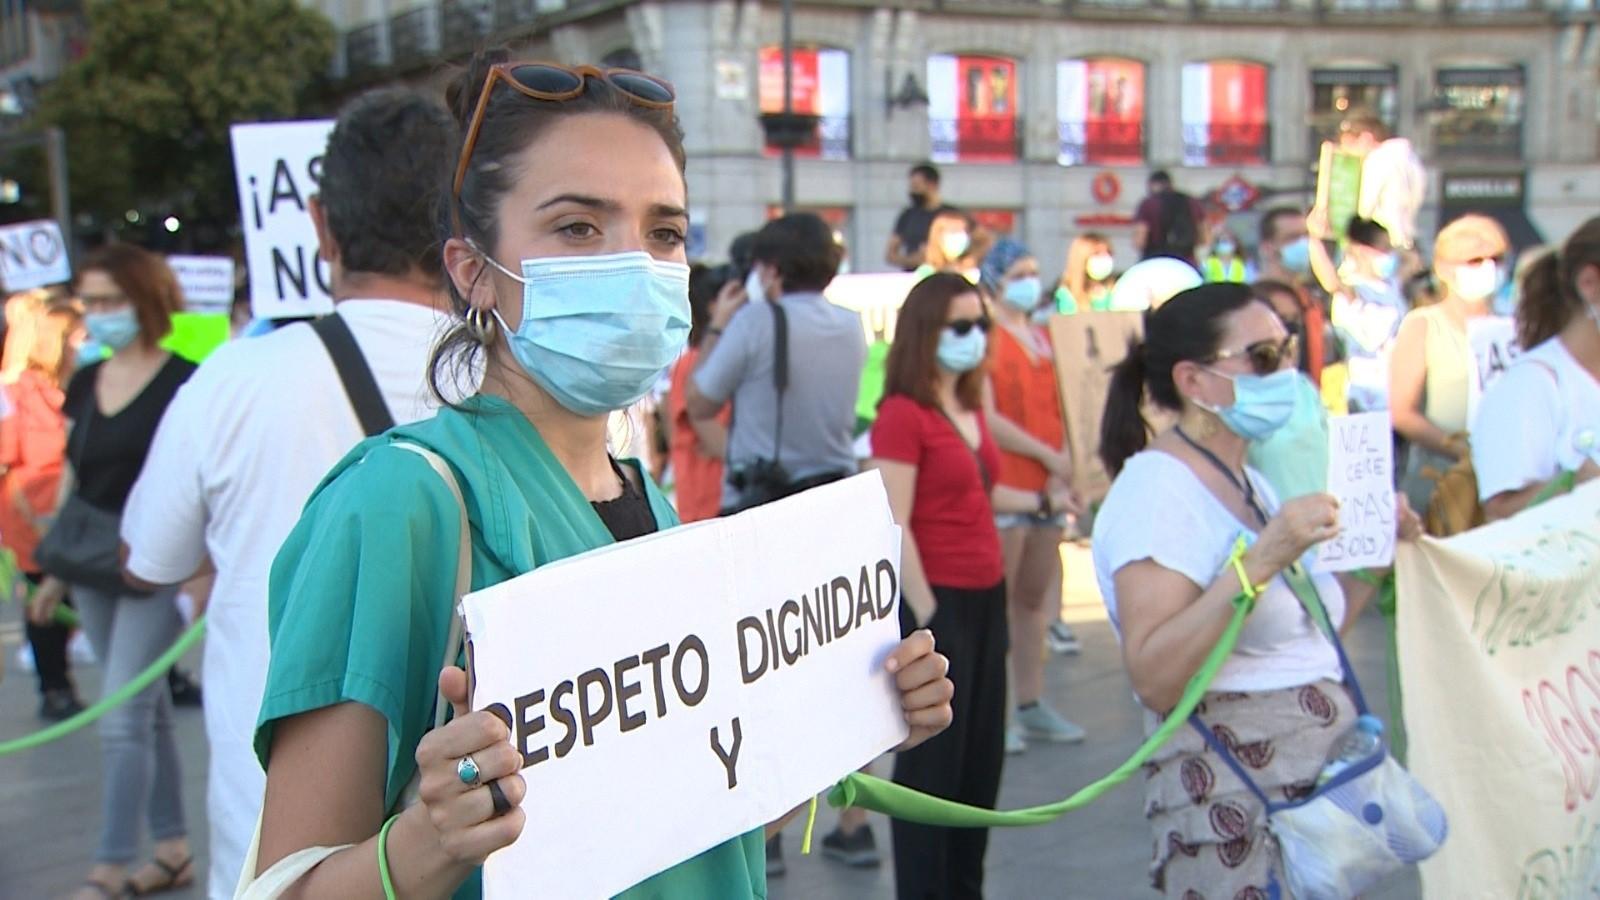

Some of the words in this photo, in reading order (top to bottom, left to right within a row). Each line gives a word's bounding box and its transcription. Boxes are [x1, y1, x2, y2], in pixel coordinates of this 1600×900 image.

[480, 634, 710, 769] ESPETO
[736, 558, 897, 684] DIGNIDAD
[710, 717, 743, 790] Y
